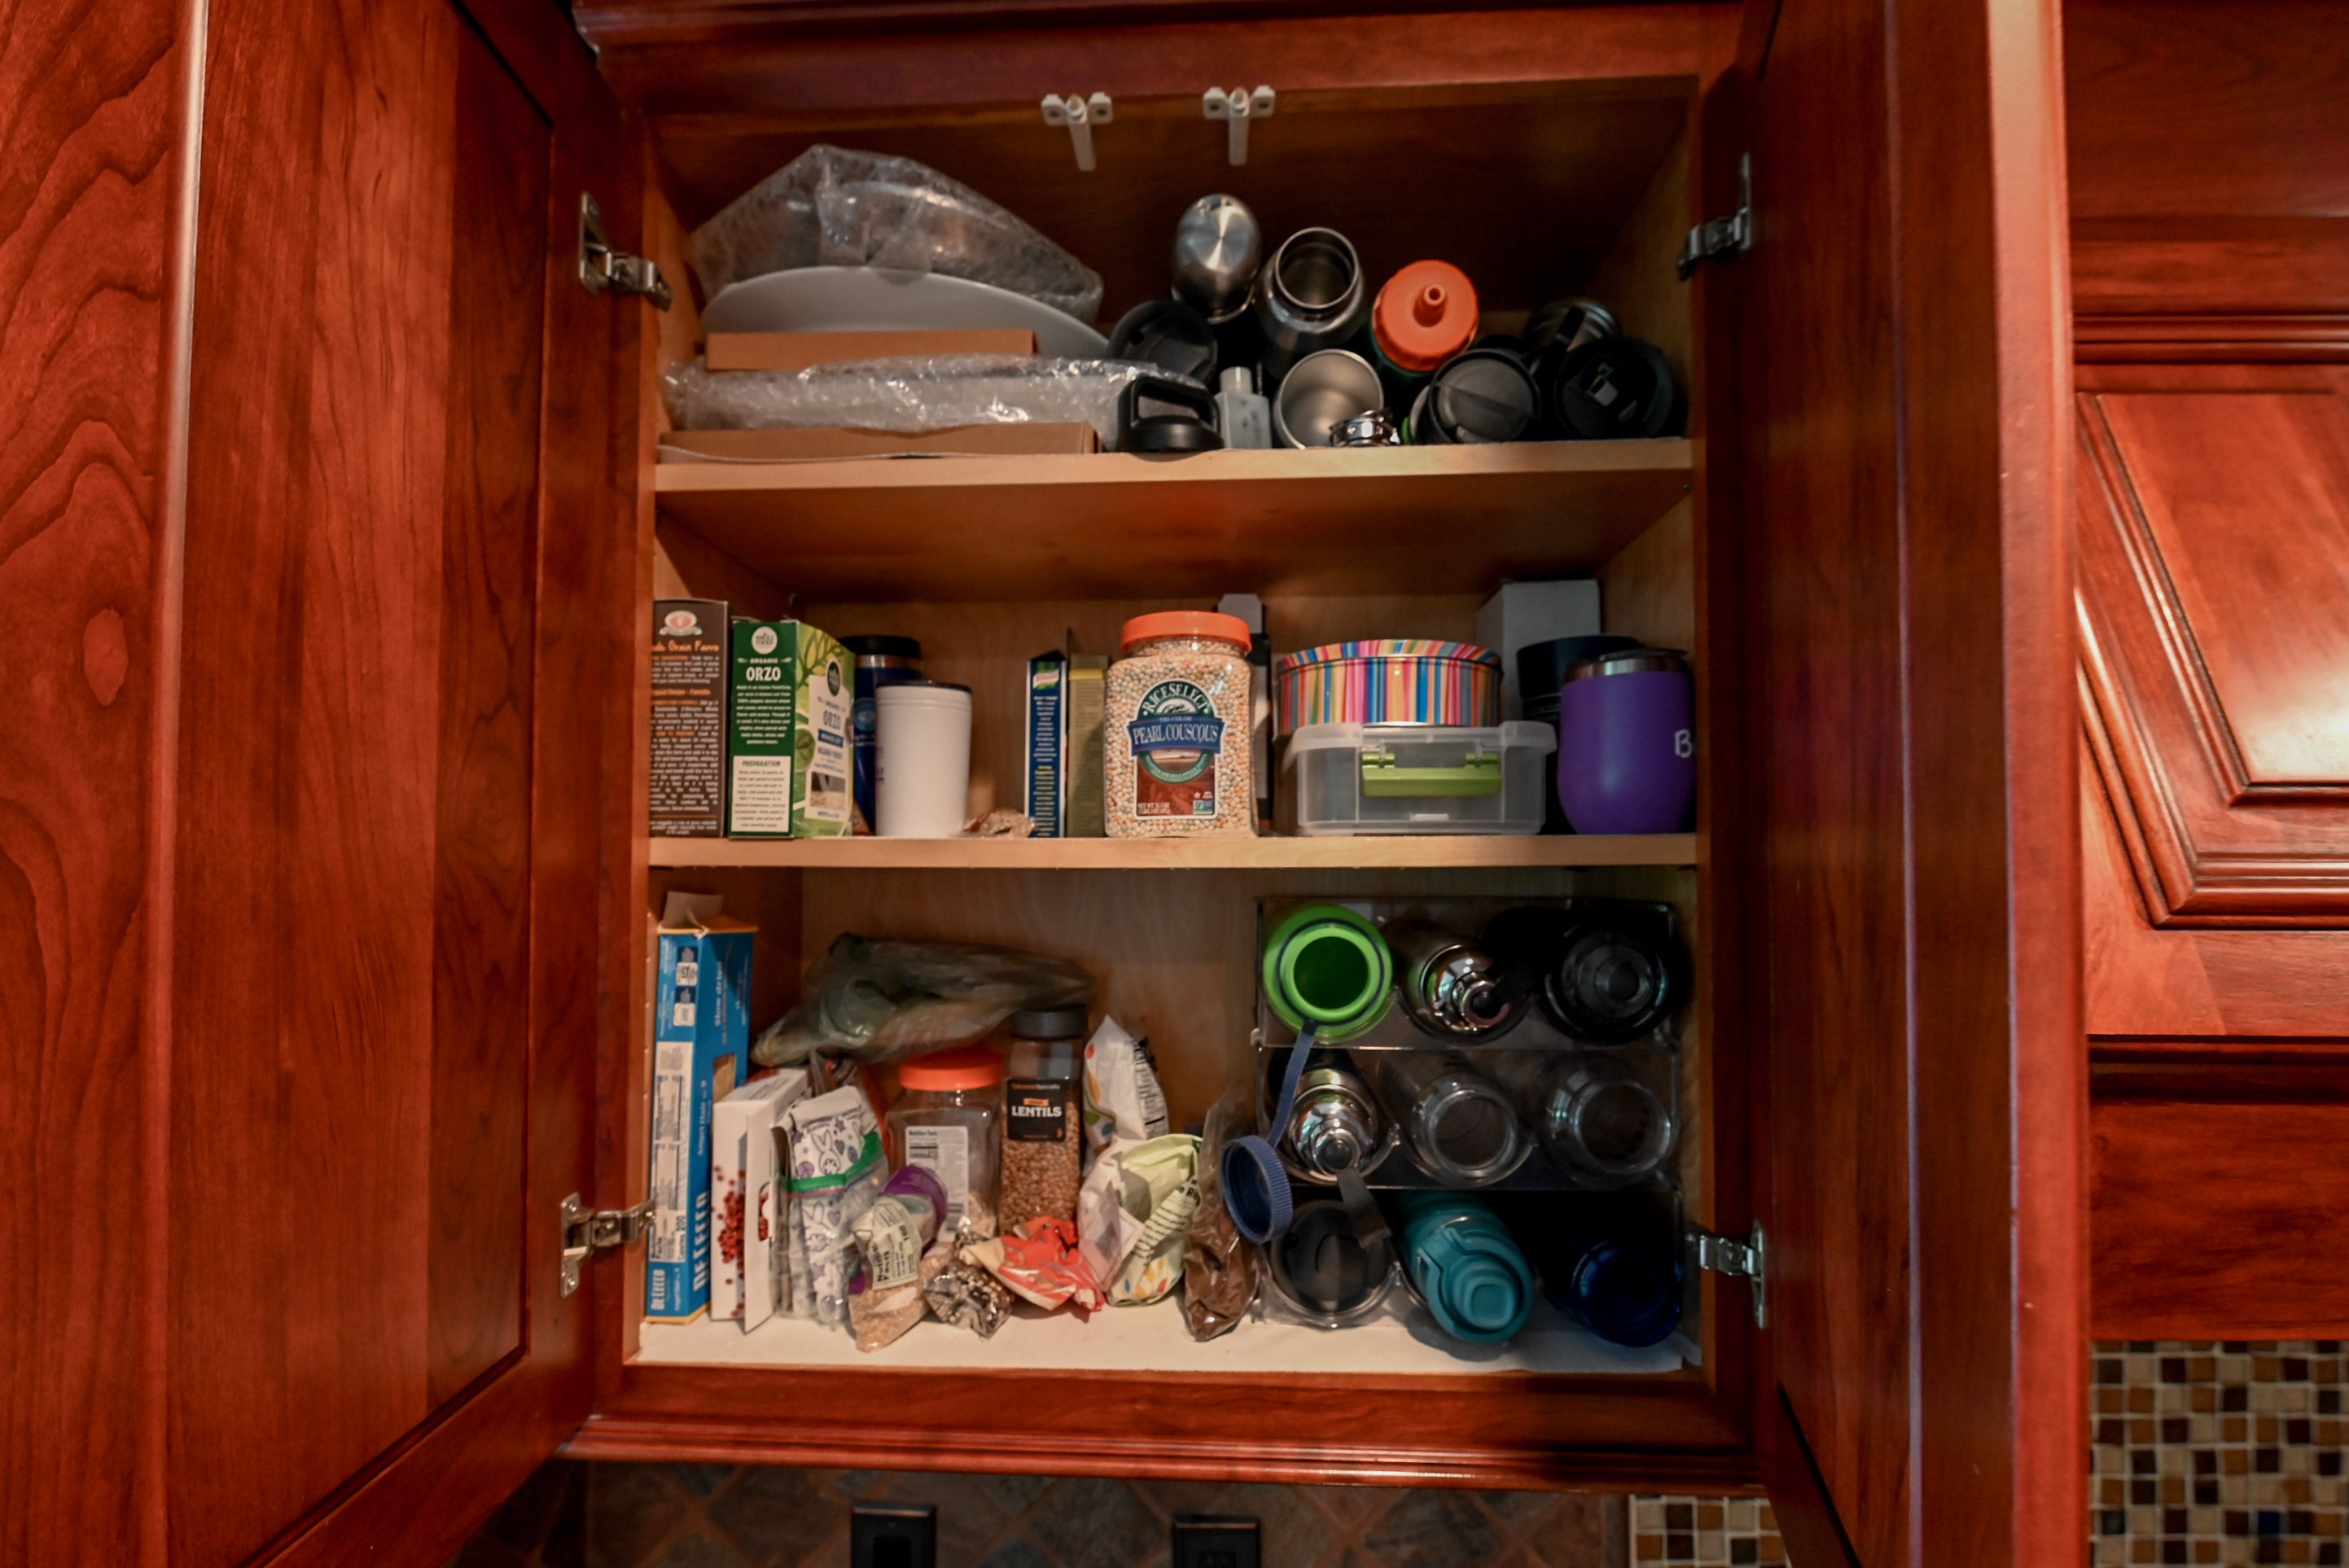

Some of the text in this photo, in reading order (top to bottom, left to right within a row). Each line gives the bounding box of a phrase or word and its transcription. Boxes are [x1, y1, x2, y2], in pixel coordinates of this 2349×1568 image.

[695, 640, 719, 651] Farro
[746, 666, 781, 681] ORZO
[823, 710, 841, 730] ORZO
[1132, 723, 1219, 745] PEARL COUSCOUS
[1011, 1106, 1062, 1118] LENTILS
[676, 1215, 686, 1232] 200
[899, 1225, 909, 1242] 160
[653, 1269, 665, 1297] CECCO
[693, 1261, 710, 1291] DE
[651, 1299, 665, 1310] DE
